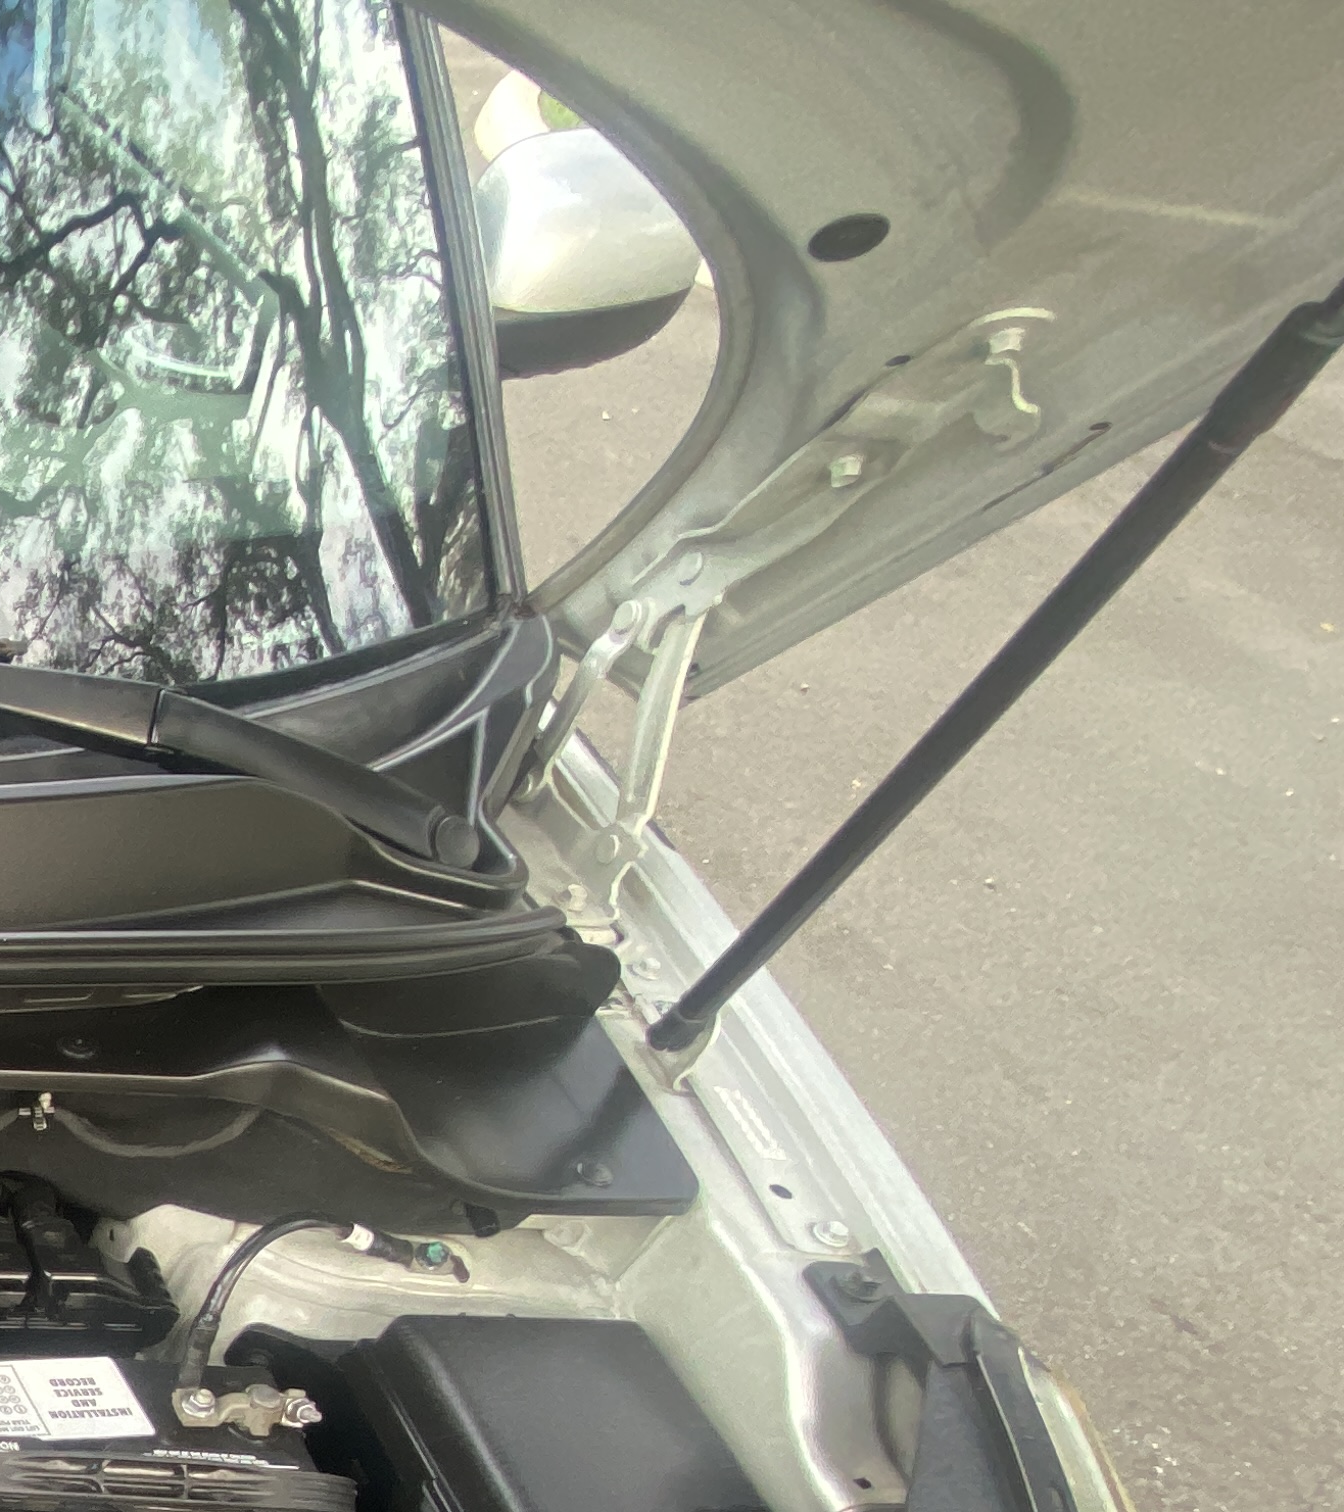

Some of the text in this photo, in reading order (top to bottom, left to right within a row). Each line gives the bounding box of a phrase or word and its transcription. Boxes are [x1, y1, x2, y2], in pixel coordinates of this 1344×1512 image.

[49, 1378, 96, 1388] RECORD
[53, 1388, 103, 1398] SERVICE
[71, 1399, 97, 1408] AND
[48, 1407, 133, 1420] INSTALLATION
